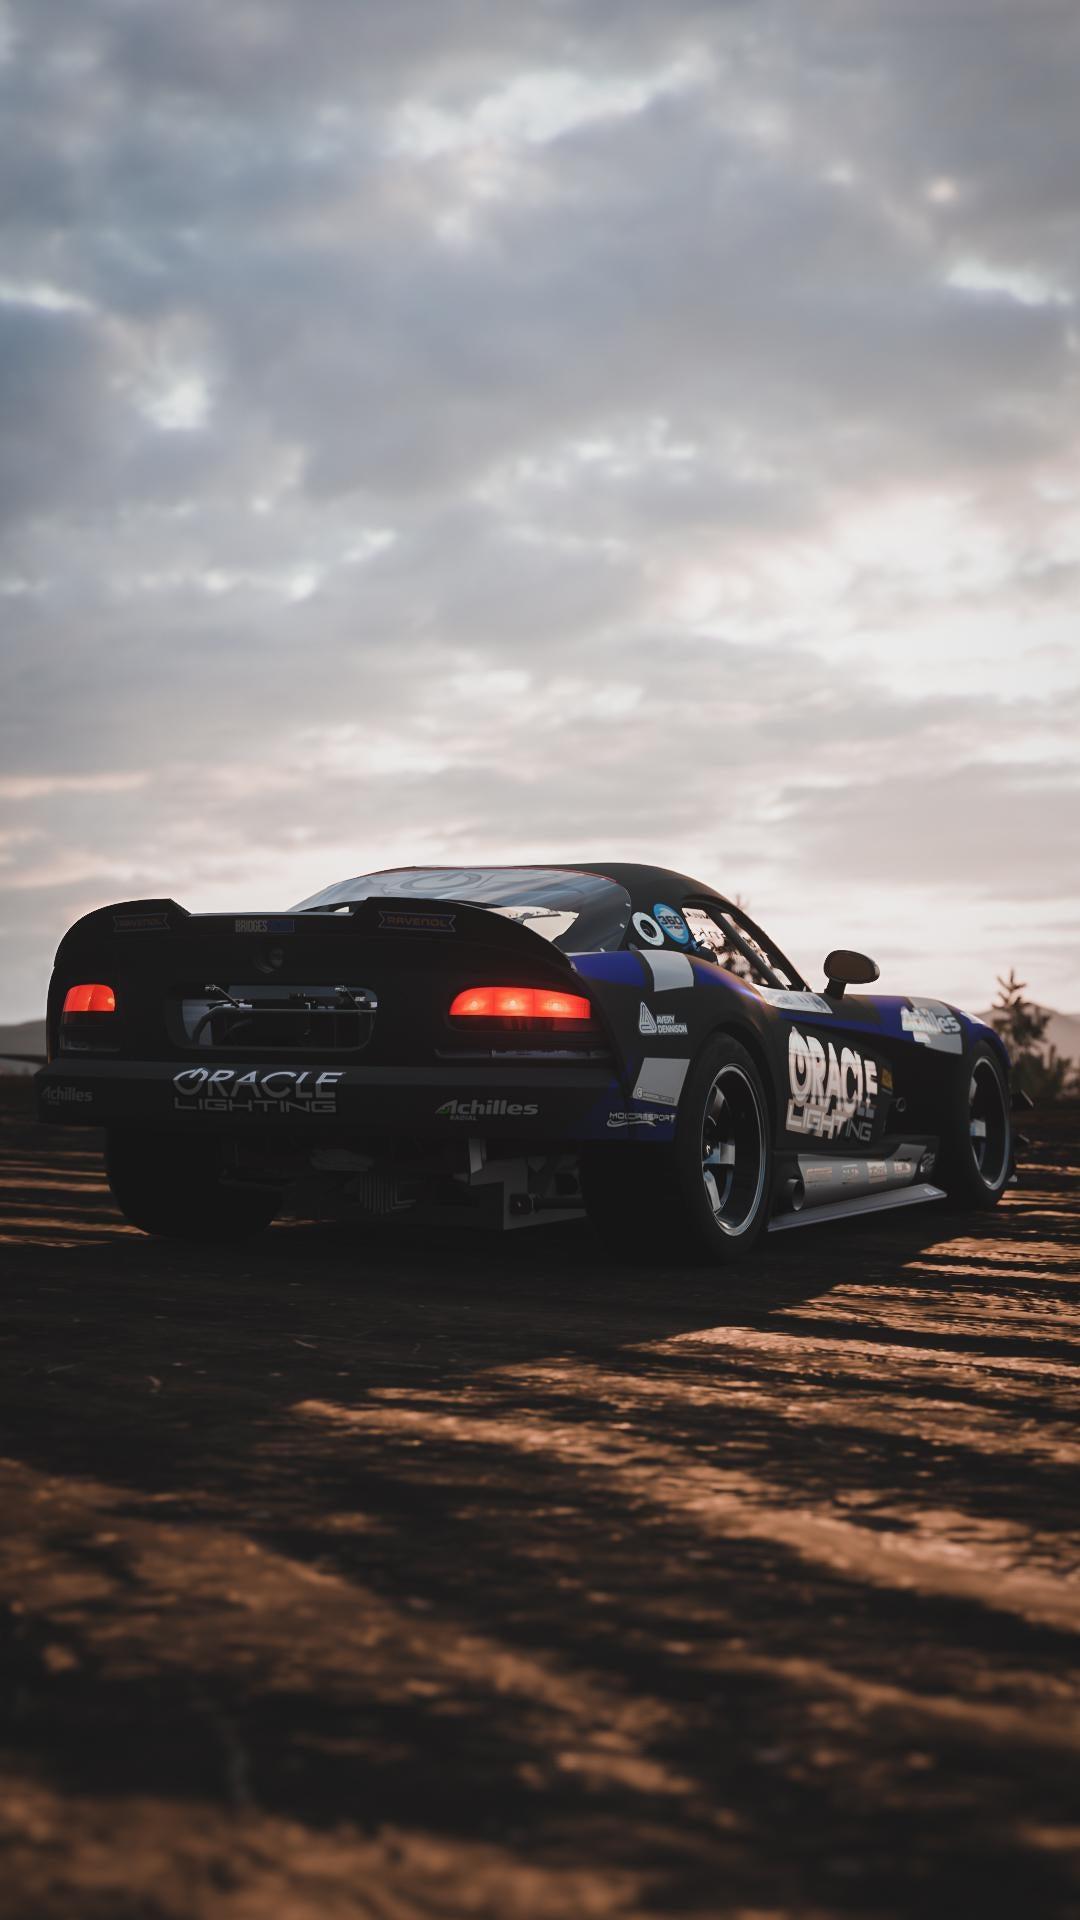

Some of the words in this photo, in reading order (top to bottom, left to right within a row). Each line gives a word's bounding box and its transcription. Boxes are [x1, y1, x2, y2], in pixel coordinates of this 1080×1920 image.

[235, 919, 268, 933] BRIDGES
[657, 915, 684, 925] 360
[656, 1015, 675, 1024] AVERY
[658, 1024, 688, 1033] DENNISON
[172, 1067, 345, 1099] ORACLE
[41, 1085, 93, 1103] Achilles
[174, 1097, 337, 1113] LIGHTING
[435, 1099, 539, 1115] Achilles
[785, 1098, 873, 1142] LIGHTING
